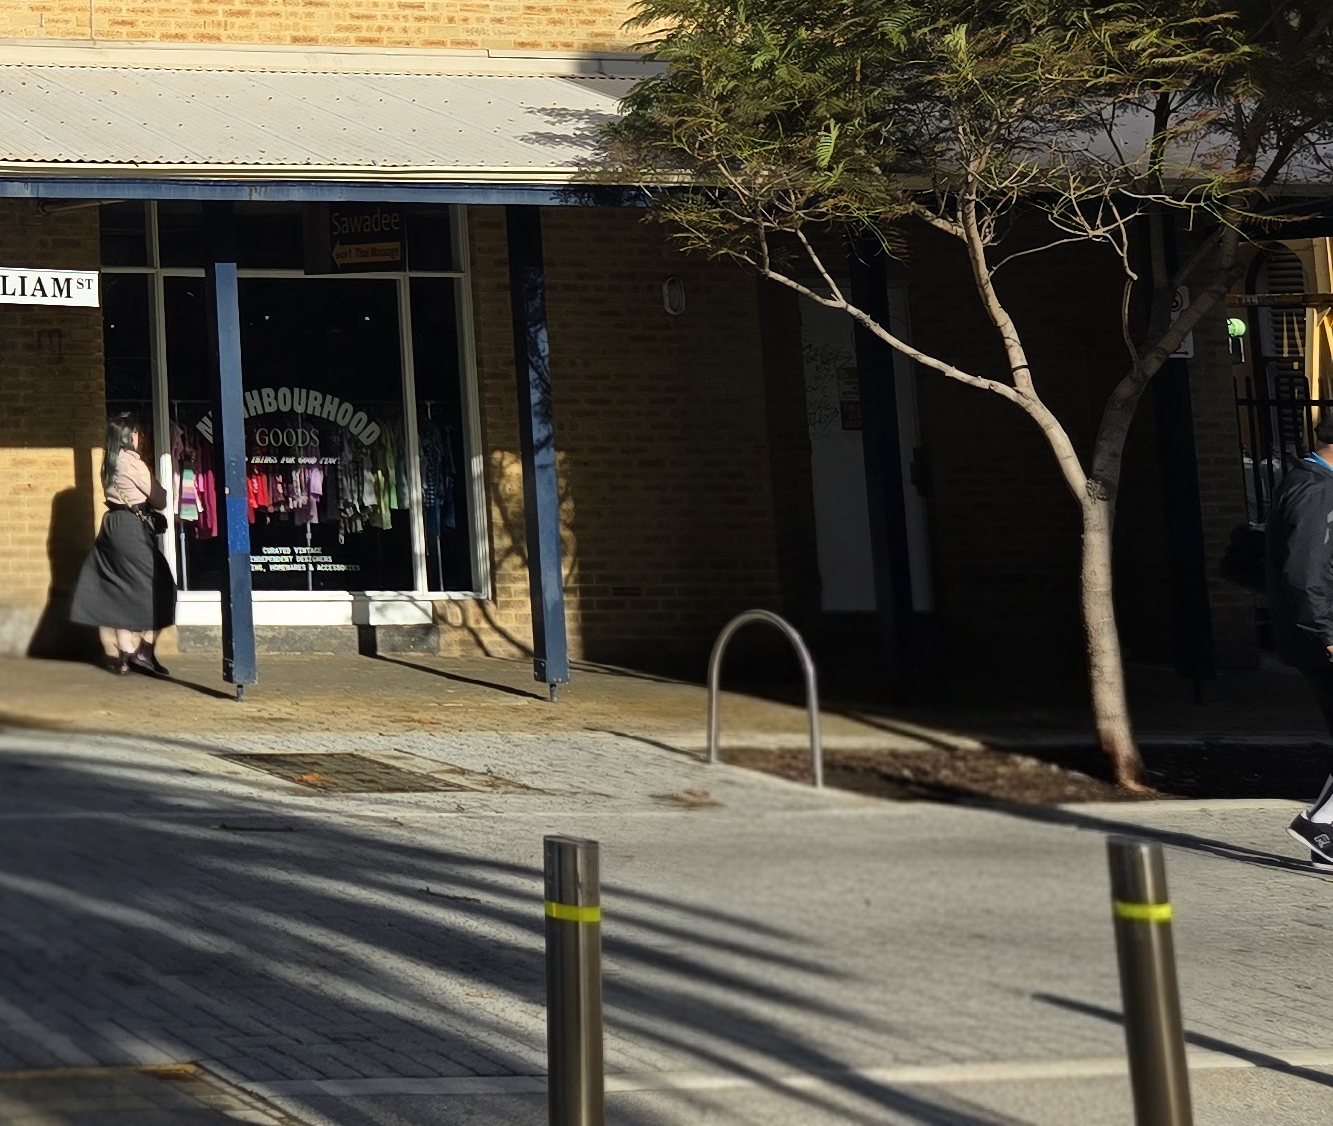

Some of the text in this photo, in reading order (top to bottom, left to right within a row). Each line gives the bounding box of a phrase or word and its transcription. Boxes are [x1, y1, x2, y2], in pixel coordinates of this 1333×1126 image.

[333, 207, 400, 235] Sawadee
[76, 278, 94, 290] ST
[255, 428, 320, 447] GOODS
